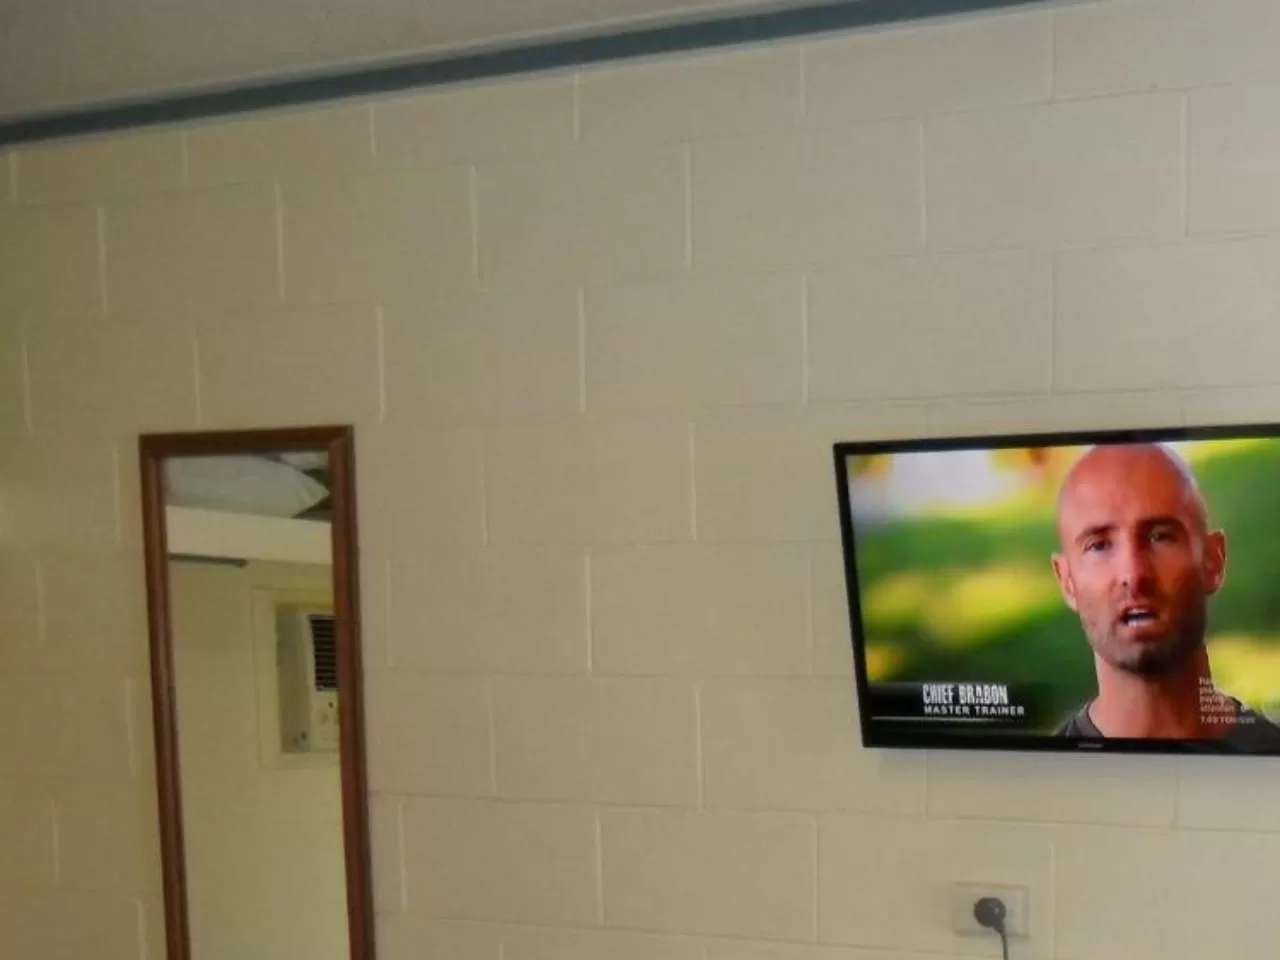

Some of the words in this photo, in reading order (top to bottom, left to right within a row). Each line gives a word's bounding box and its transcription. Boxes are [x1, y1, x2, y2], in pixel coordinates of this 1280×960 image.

[922, 683, 954, 704] CHIEF
[958, 684, 1008, 705] BRABON
[923, 705, 970, 715] MASTER
[974, 705, 1025, 716] TRAINER
